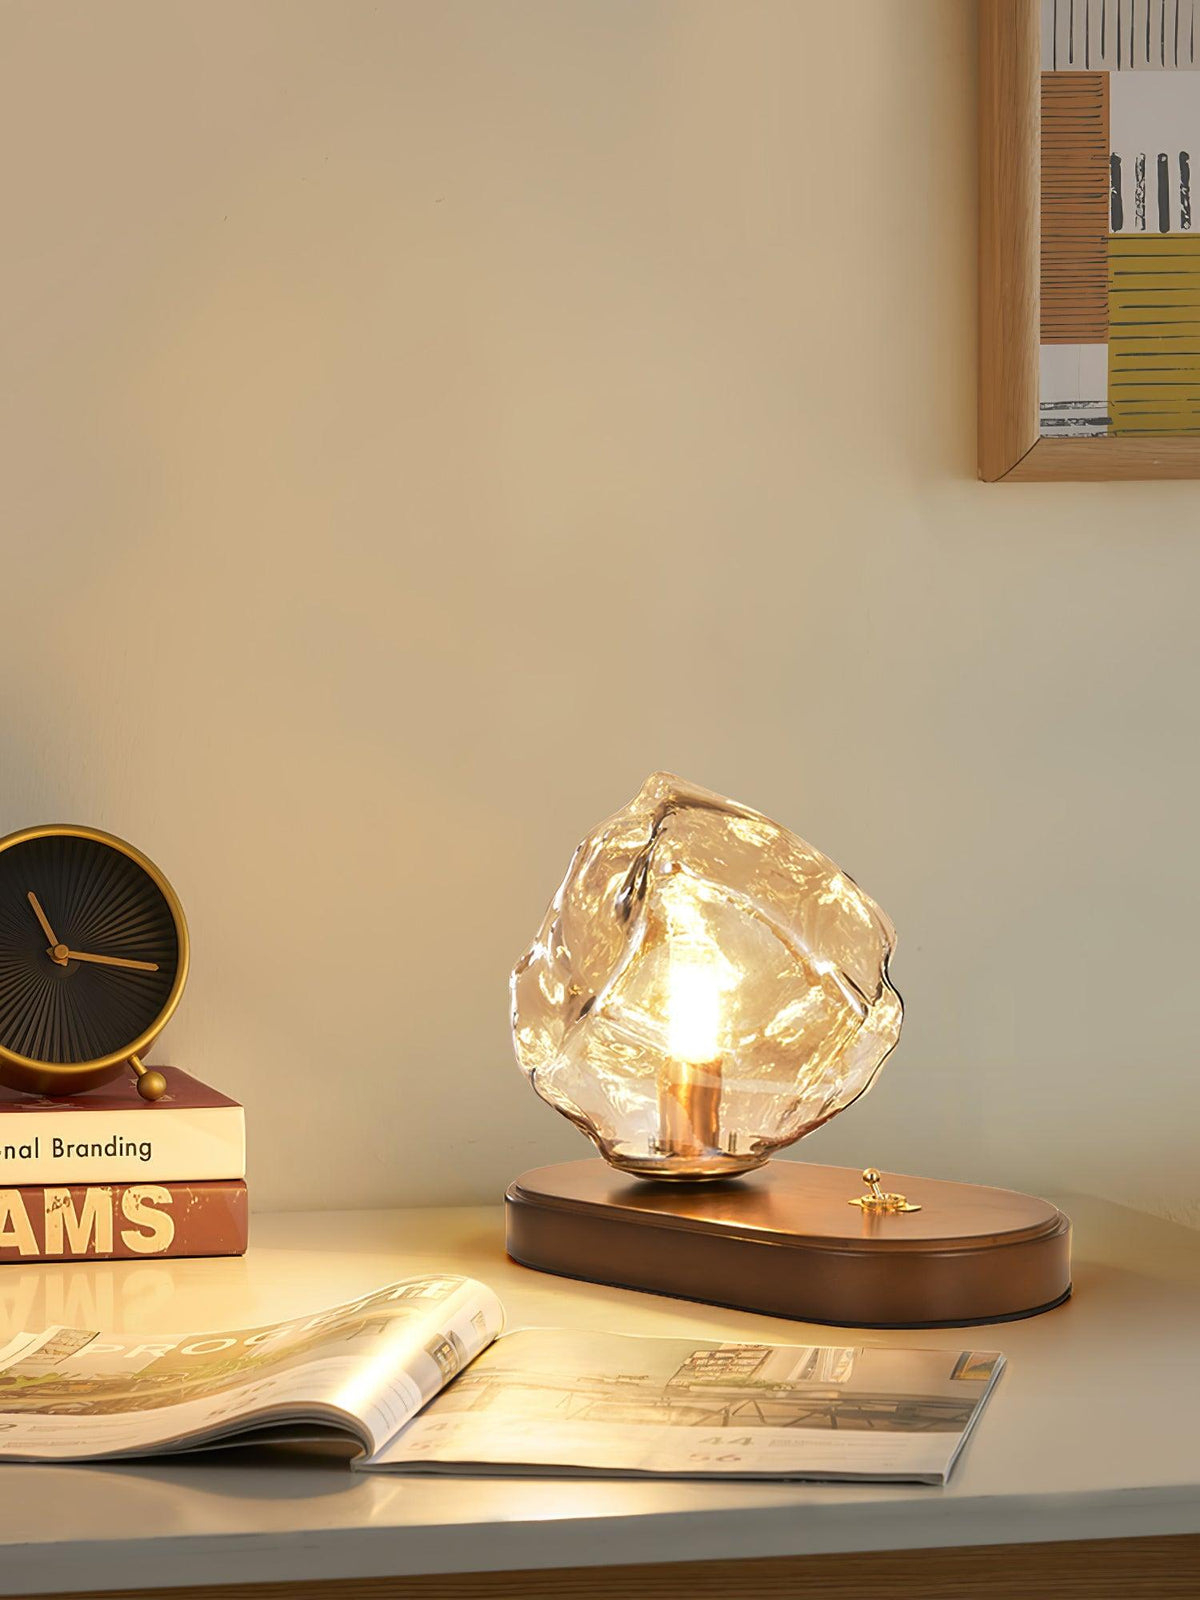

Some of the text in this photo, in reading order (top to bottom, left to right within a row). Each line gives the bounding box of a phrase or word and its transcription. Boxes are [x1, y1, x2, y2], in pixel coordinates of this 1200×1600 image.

[0, 1135, 152, 1162] nal Branding
[0, 1184, 176, 1256] AMS
